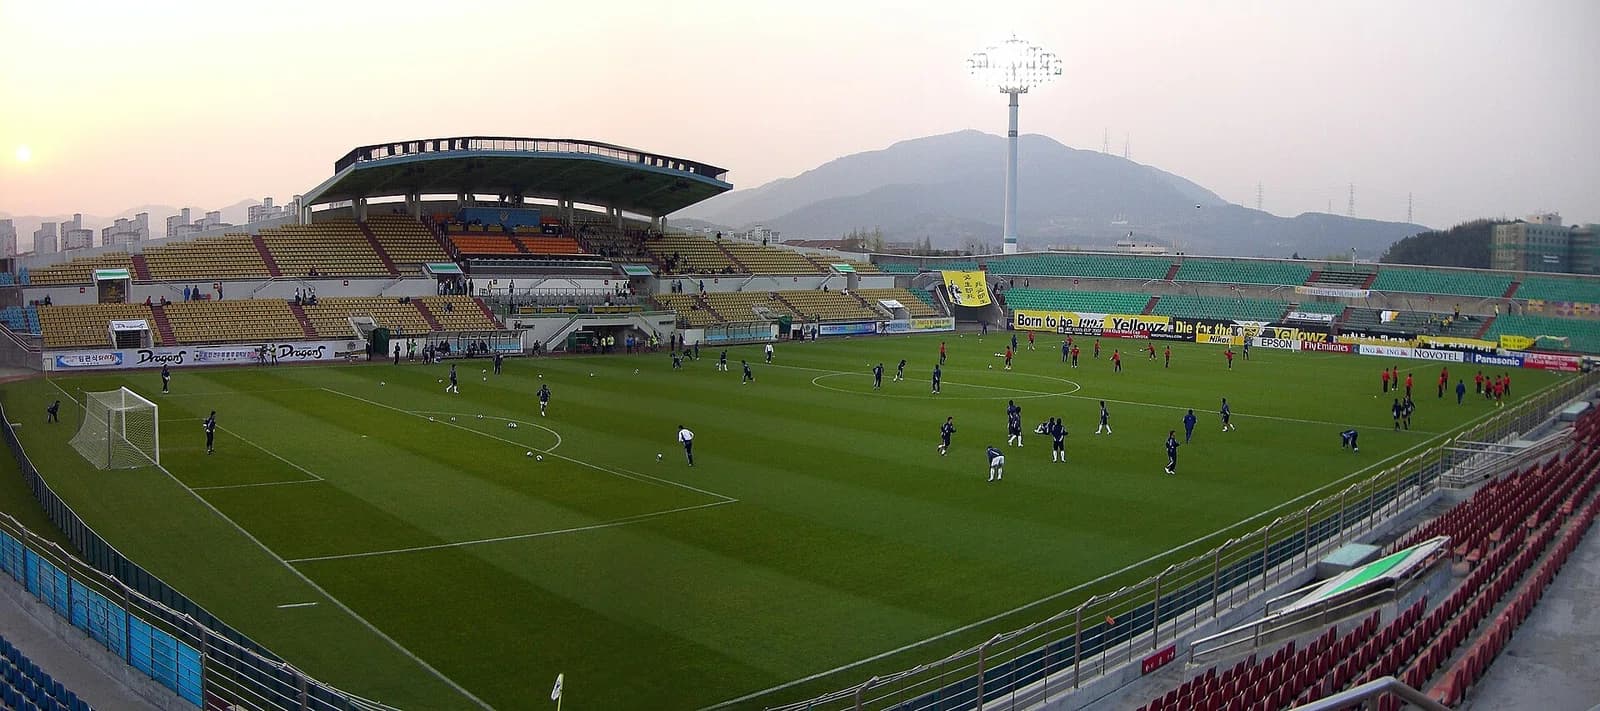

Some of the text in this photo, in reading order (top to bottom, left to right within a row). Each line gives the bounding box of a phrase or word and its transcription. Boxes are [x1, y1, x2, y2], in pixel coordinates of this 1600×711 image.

[1017, 314, 1042, 327] Born
[1046, 315, 1057, 328] to
[1060, 316, 1073, 327] be
[1175, 321, 1193, 333] Die
[1195, 322, 1211, 335] for
[1273, 327, 1328, 343] Yellowz
[1261, 339, 1293, 348] EPSON
[1304, 341, 1349, 352] Fly Emirates
[1362, 345, 1375, 354] ING
[1386, 347, 1399, 356] ING
[1414, 349, 1459, 360] NOVOTEL
[1475, 354, 1520, 366] Panasonic
